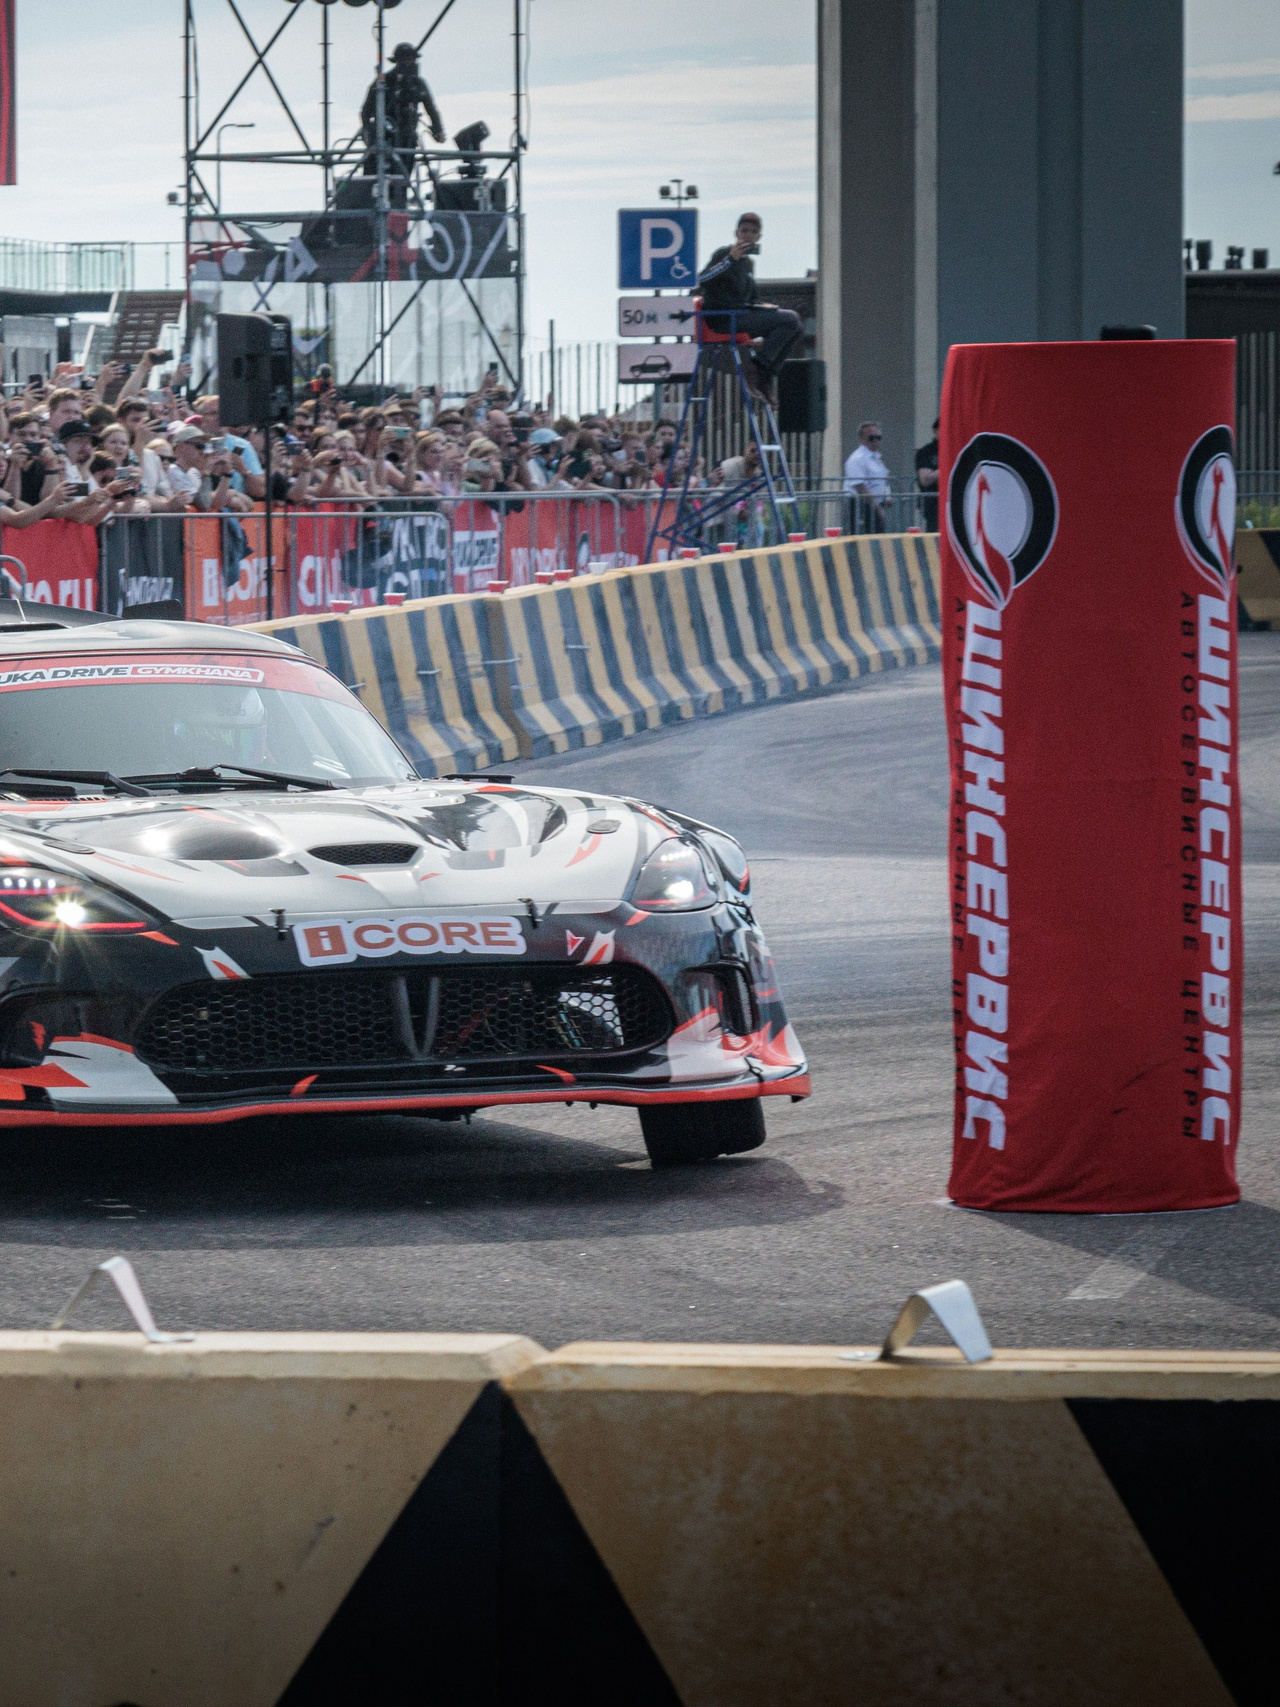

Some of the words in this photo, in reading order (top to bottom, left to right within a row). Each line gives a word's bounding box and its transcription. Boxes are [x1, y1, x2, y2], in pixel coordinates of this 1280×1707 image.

[640, 218, 684, 280] P
[52, 666, 129, 680] DRIVE
[137, 666, 253, 679] GYMKHANA
[1181, 591, 1198, 950] АВТОСЕРВИСНЫЕ
[961, 600, 1009, 1150] ШИНСЕРВИС
[1197, 593, 1231, 1145] ШИНСЕРВИС
[1181, 979, 1199, 1139] ЦЕНТРЫ
